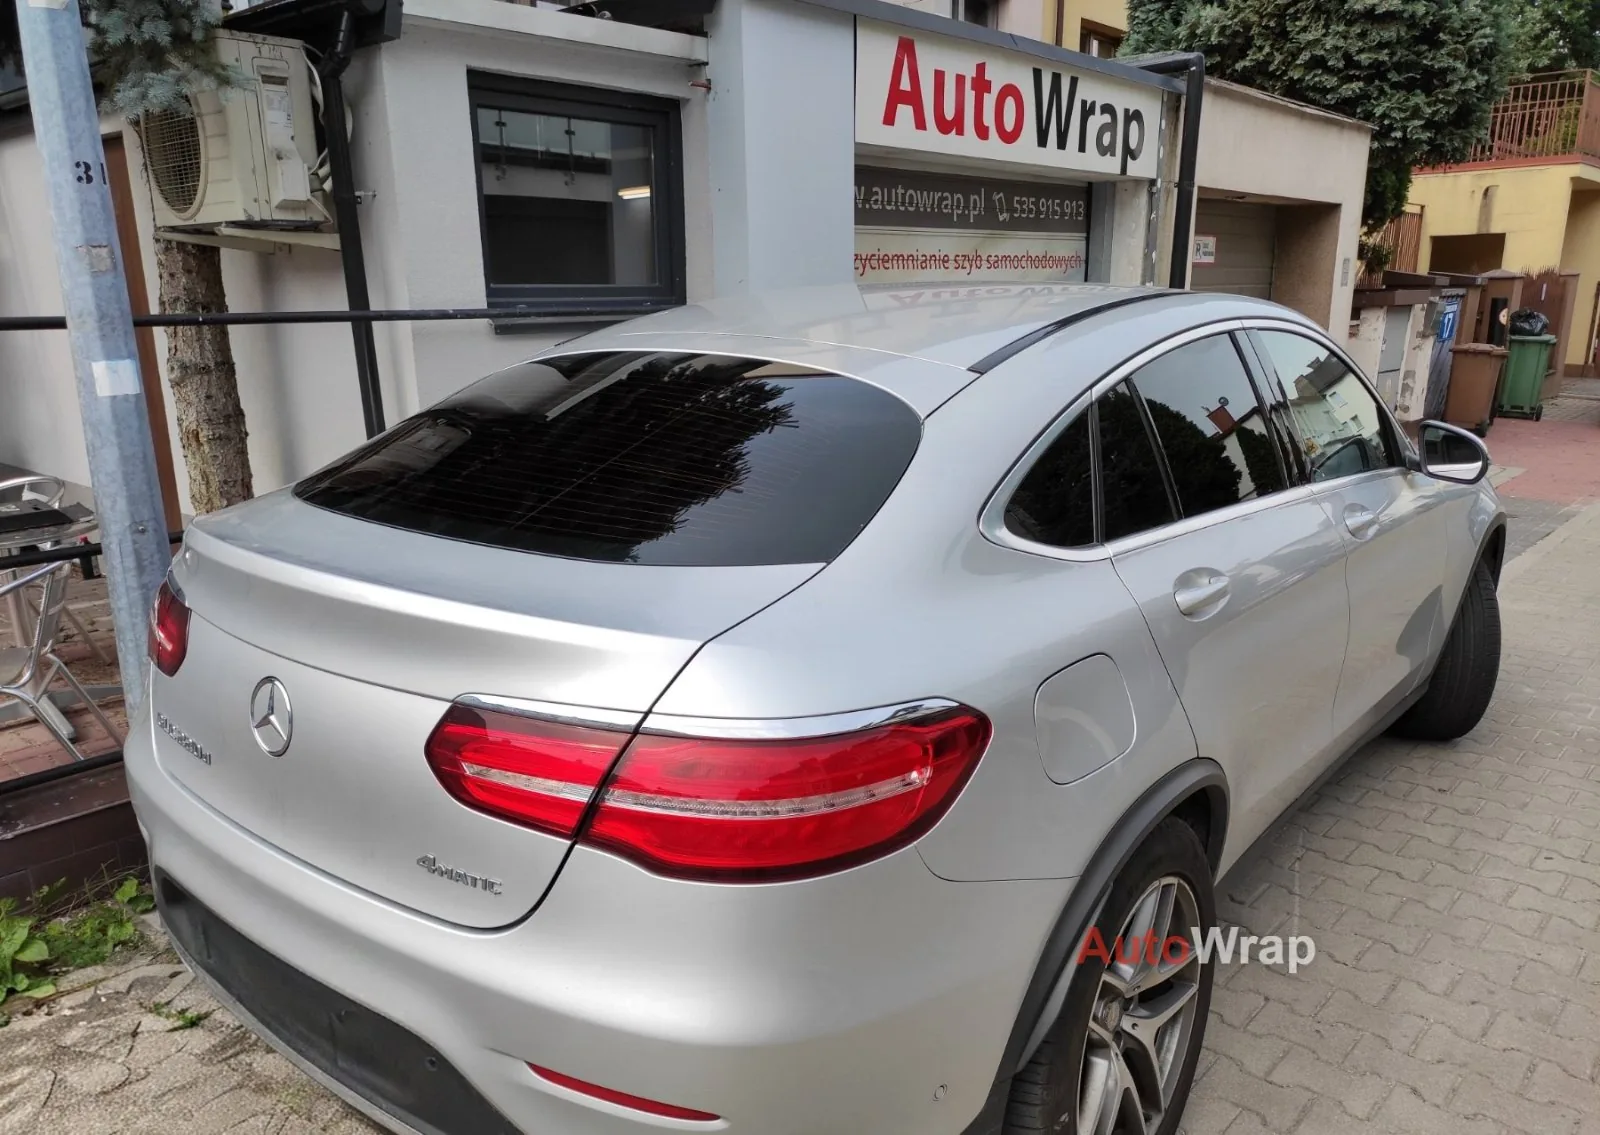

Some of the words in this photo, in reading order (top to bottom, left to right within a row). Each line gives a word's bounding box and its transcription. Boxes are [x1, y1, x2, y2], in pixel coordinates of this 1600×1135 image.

[882, 35, 1145, 176] AutoWrap
[1013, 196, 1036, 218] 535
[1039, 198, 1061, 219] 915
[1063, 200, 1085, 220] 913
[953, 249, 983, 275] szyb
[986, 250, 1082, 274] samochodowych
[1442, 312, 1454, 339] 17
